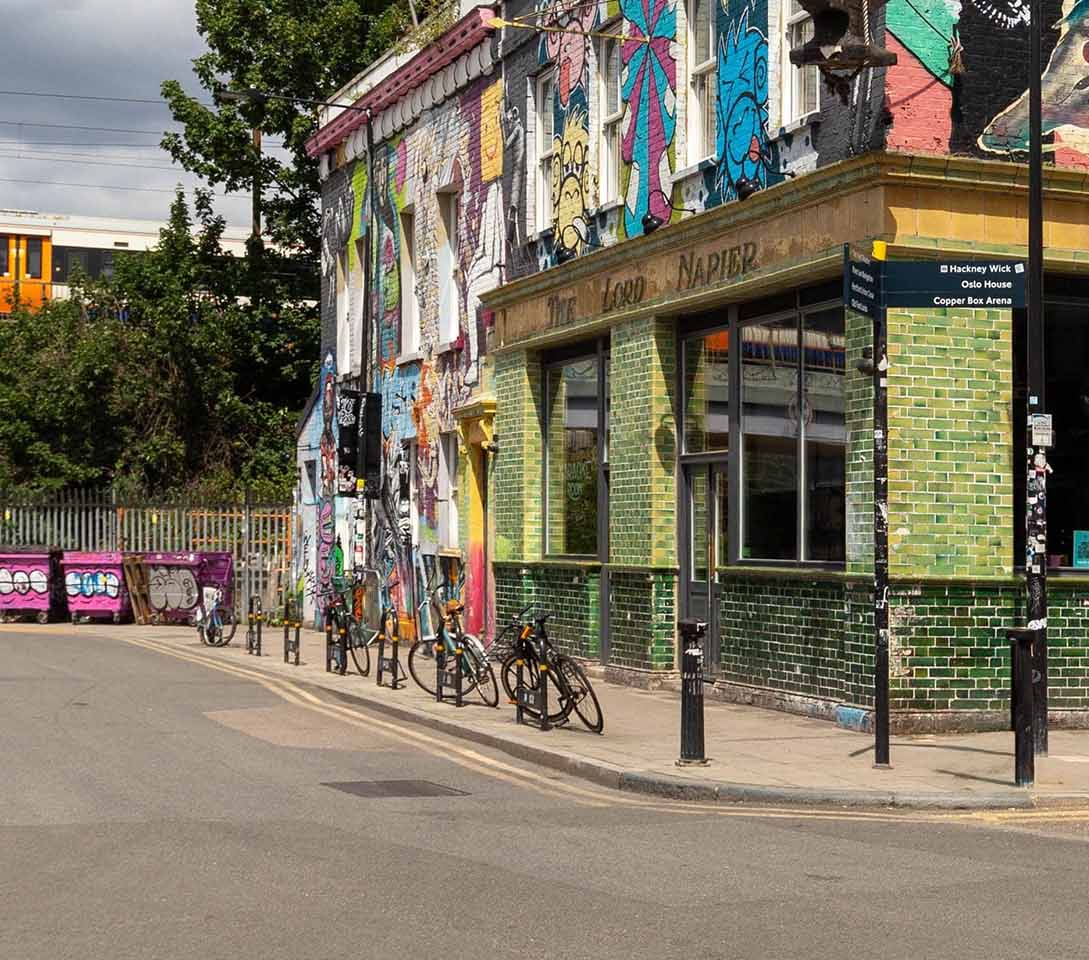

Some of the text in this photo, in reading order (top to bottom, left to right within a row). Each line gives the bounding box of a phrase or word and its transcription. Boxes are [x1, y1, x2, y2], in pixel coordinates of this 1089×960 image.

[949, 264, 1012, 275] Hackney Wick
[547, 242, 759, 326] THE LORD NAPIER
[961, 280, 1012, 289] Oslo House
[933, 296, 1012, 306] Copper Box Arena
